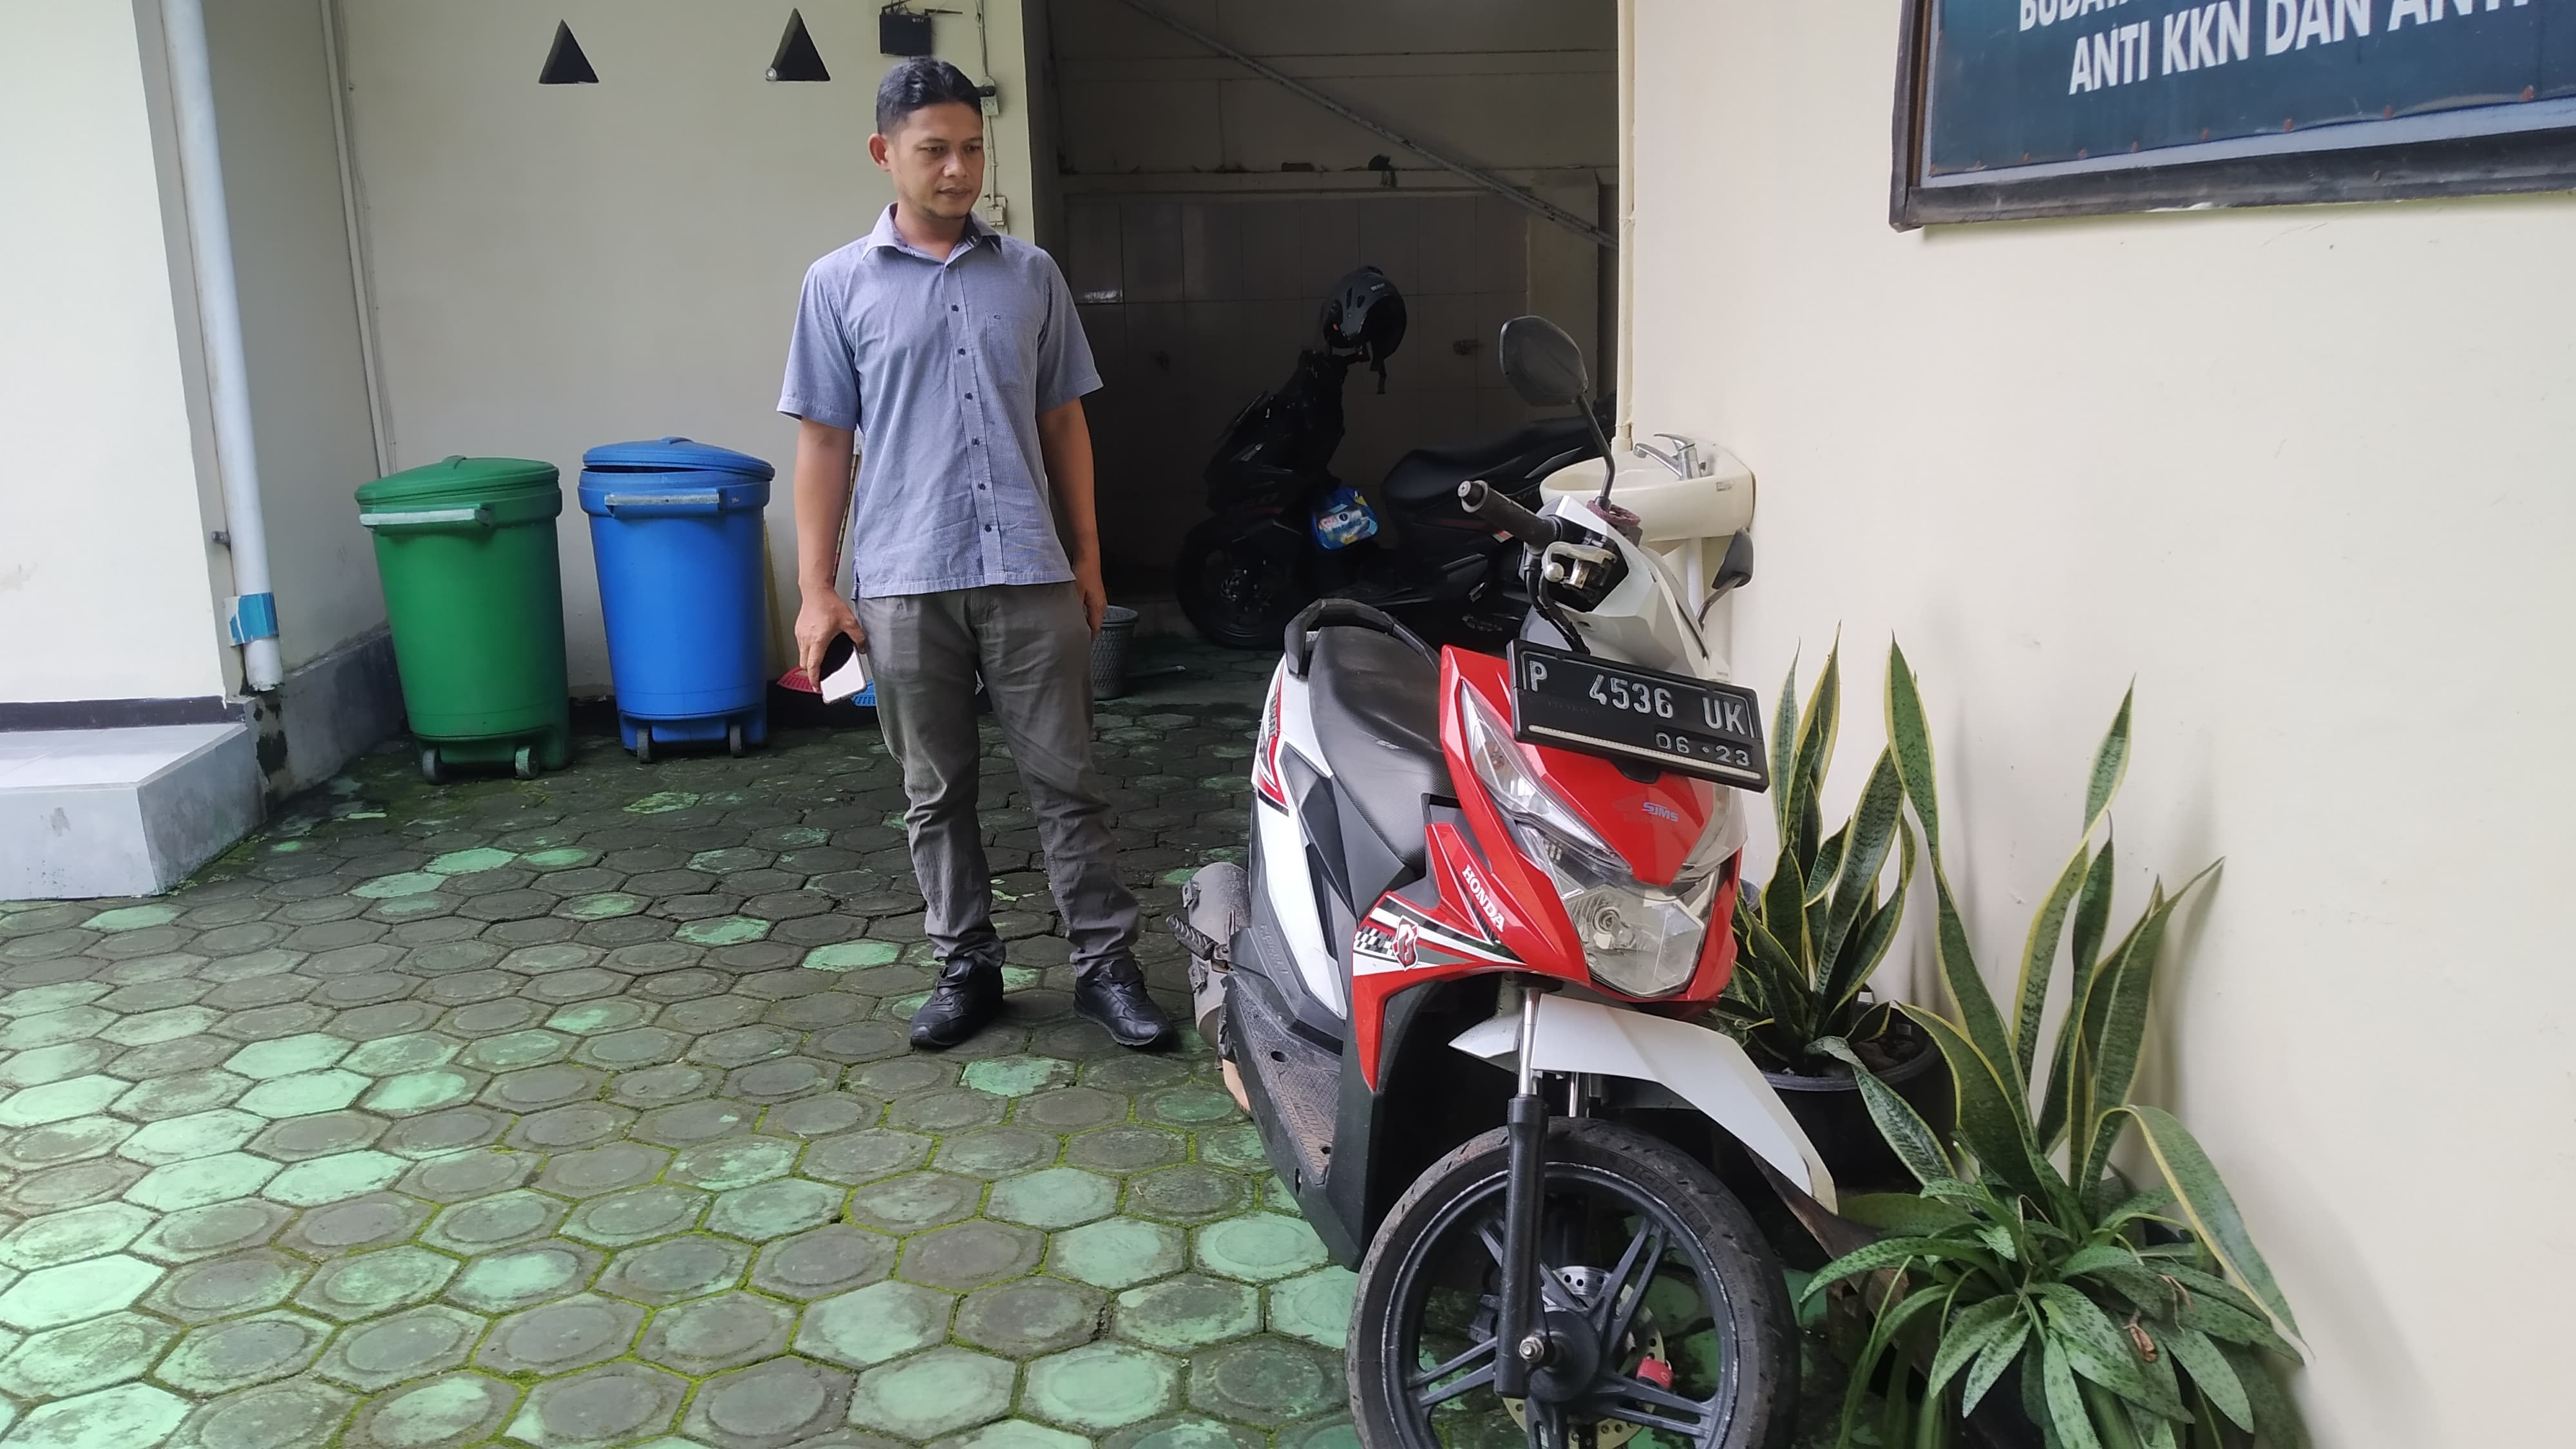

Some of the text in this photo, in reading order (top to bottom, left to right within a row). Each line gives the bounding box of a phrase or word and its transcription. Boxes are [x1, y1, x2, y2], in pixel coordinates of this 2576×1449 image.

[2069, 21, 2150, 95] ANTI
[2162, 0, 2250, 75] KKN
[2265, 0, 2371, 56] DAN
[1528, 660, 1548, 692] P
[1589, 674, 1674, 719] 4536
[1702, 696, 1745, 735] UK
[1462, 864, 1506, 932] HONDA
